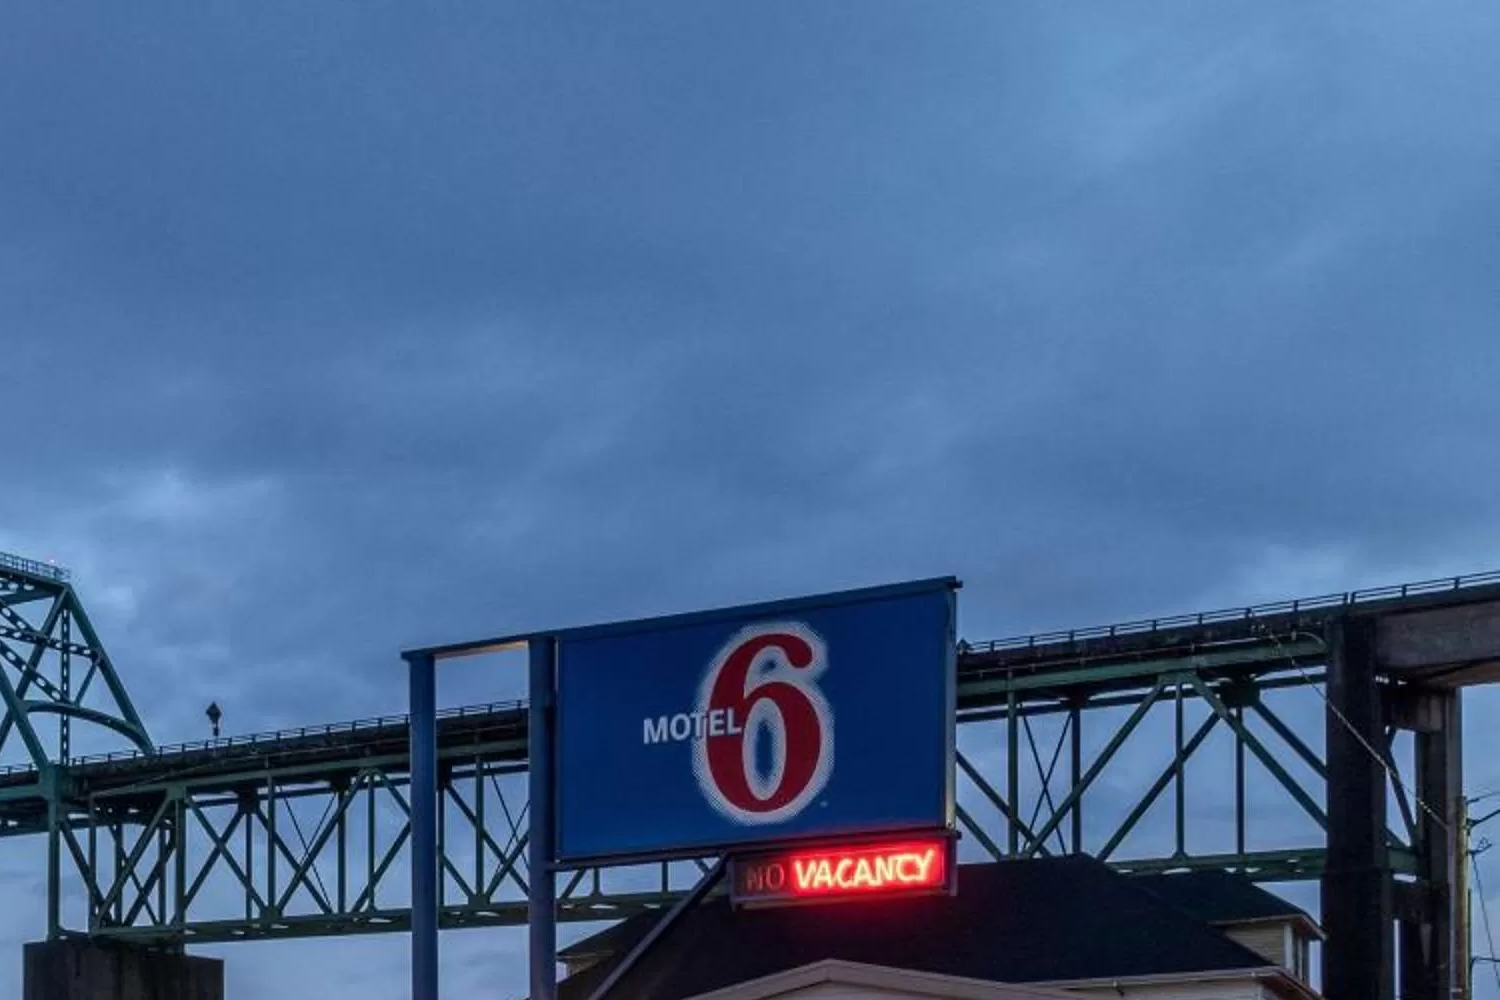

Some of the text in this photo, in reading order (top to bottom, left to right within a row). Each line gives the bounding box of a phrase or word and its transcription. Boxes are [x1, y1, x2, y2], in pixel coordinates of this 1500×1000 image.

[643, 630, 823, 815] MOTEL 6
[746, 848, 935, 891] NO VACANCY
